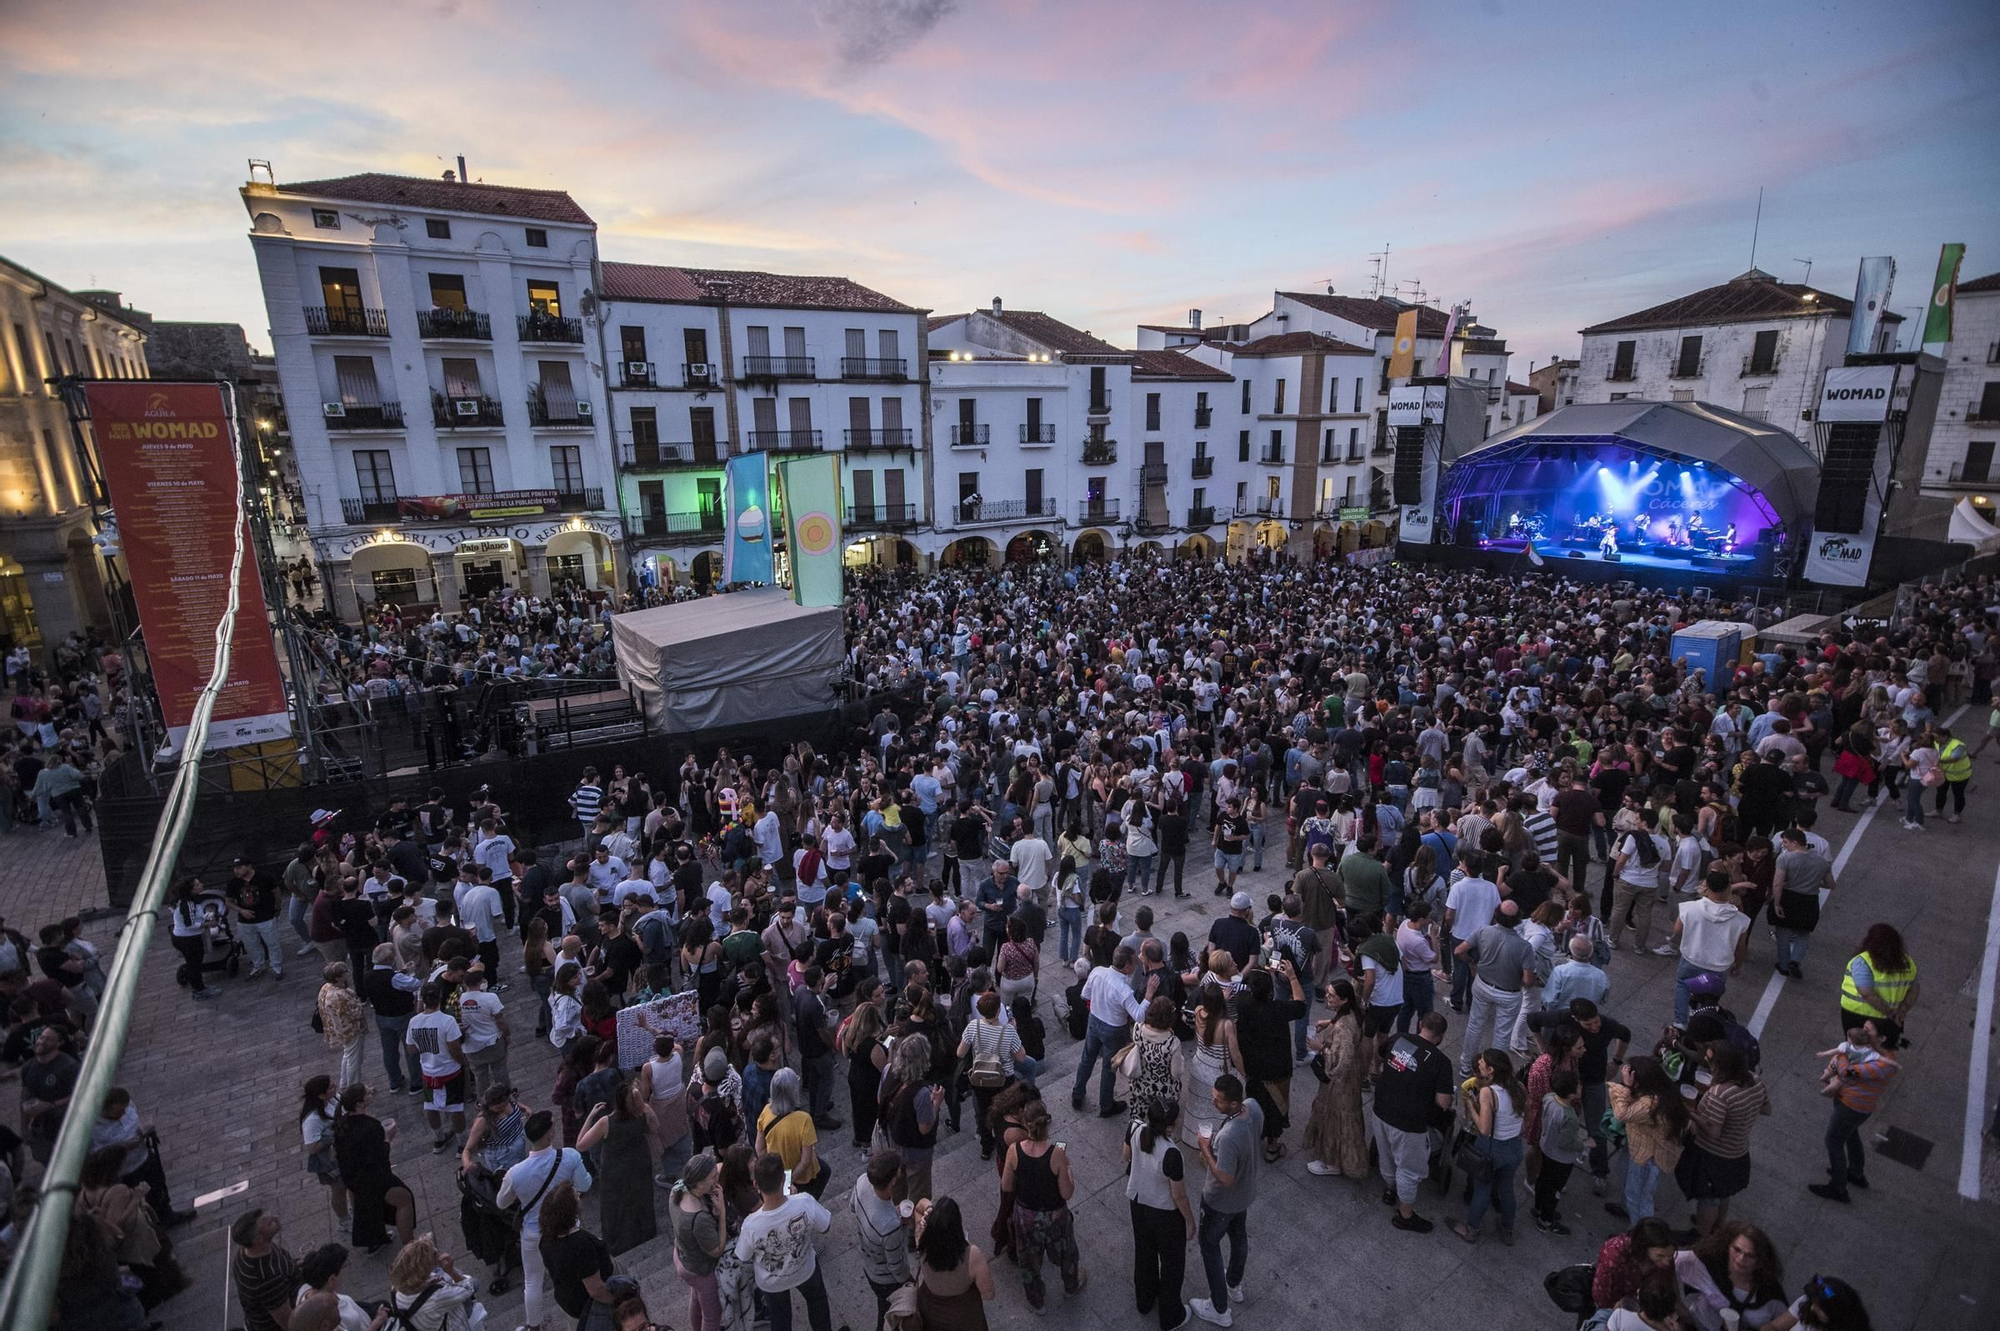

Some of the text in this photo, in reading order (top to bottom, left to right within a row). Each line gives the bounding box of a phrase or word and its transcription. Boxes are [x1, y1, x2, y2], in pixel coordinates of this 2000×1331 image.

[1827, 388, 1886, 401] WOMAD
[1391, 401, 1420, 411] WOMAD
[1425, 400, 1445, 409] WOMAD
[132, 422, 218, 438] WOMAD
[493, 492, 520, 500] INMEDIATO
[464, 501, 500, 509] SUFRIMIENTO
[1649, 497, 1719, 510] Cáceres
[461, 543, 479, 553] Pato
[480, 541, 509, 552] Blanco
